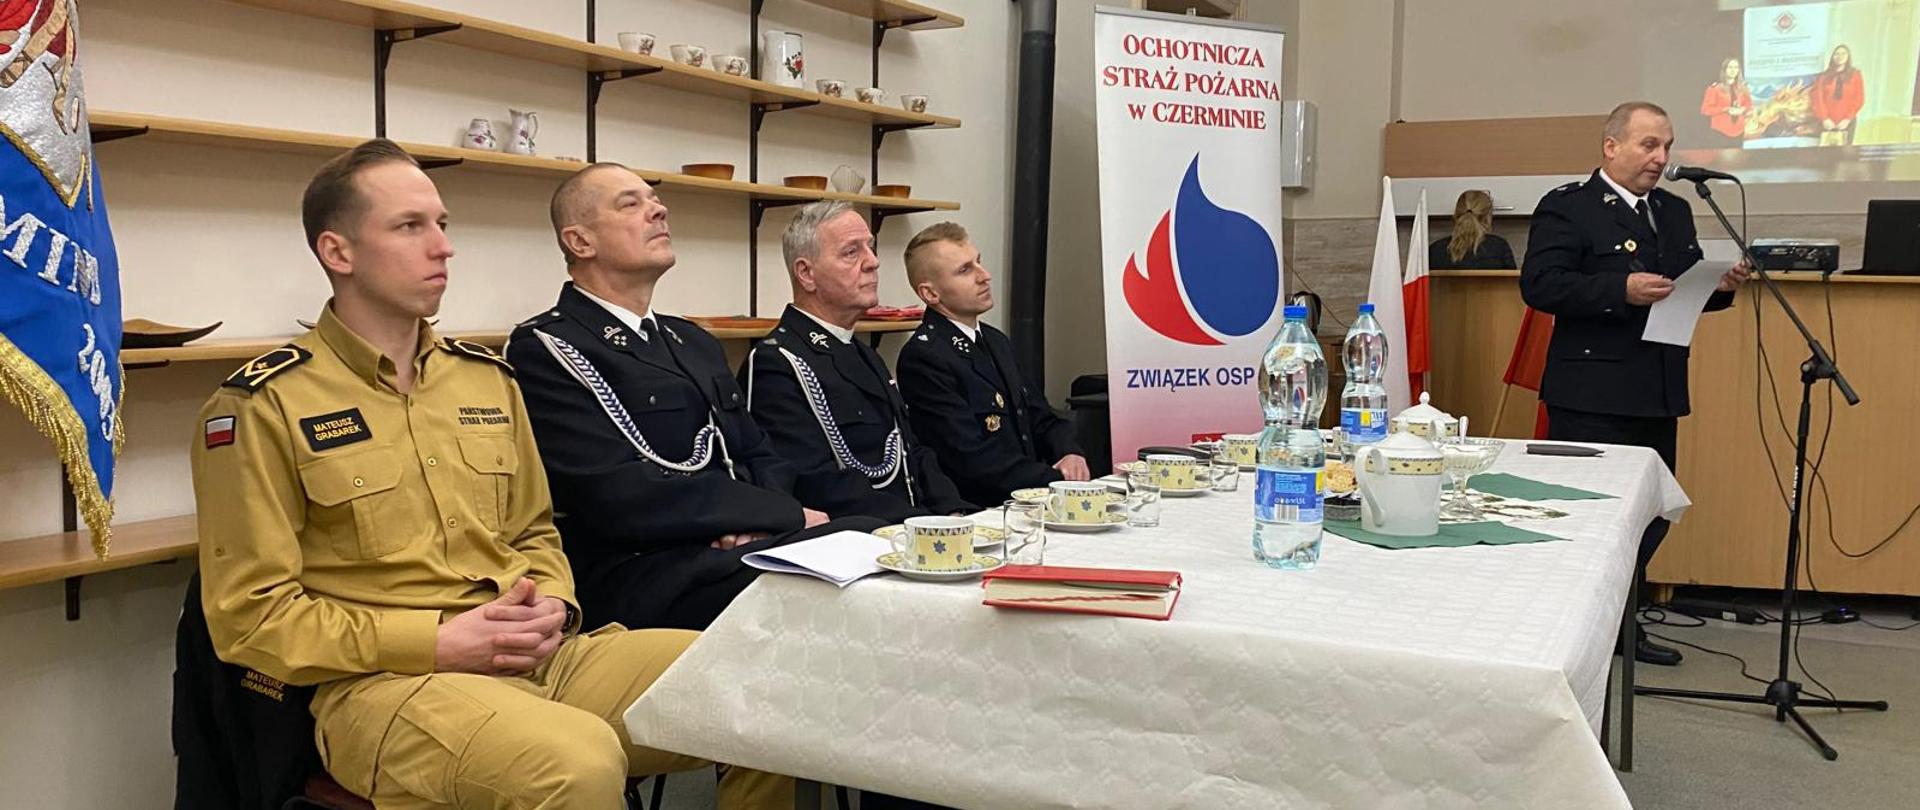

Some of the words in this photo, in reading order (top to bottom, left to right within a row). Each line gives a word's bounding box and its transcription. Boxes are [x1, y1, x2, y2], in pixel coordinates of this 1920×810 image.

[1123, 34, 1265, 68] OCHOTNICZA
[1103, 65, 1179, 91] STRAŻ
[1185, 71, 1280, 101] POŻARNA
[1152, 102, 1266, 129] CZERMINIE
[1126, 368, 1211, 392] ZWIĄZEK
[1216, 367, 1255, 386] OSP
[313, 416, 355, 432] MATEUSZ
[315, 424, 362, 441] GRABAREK
